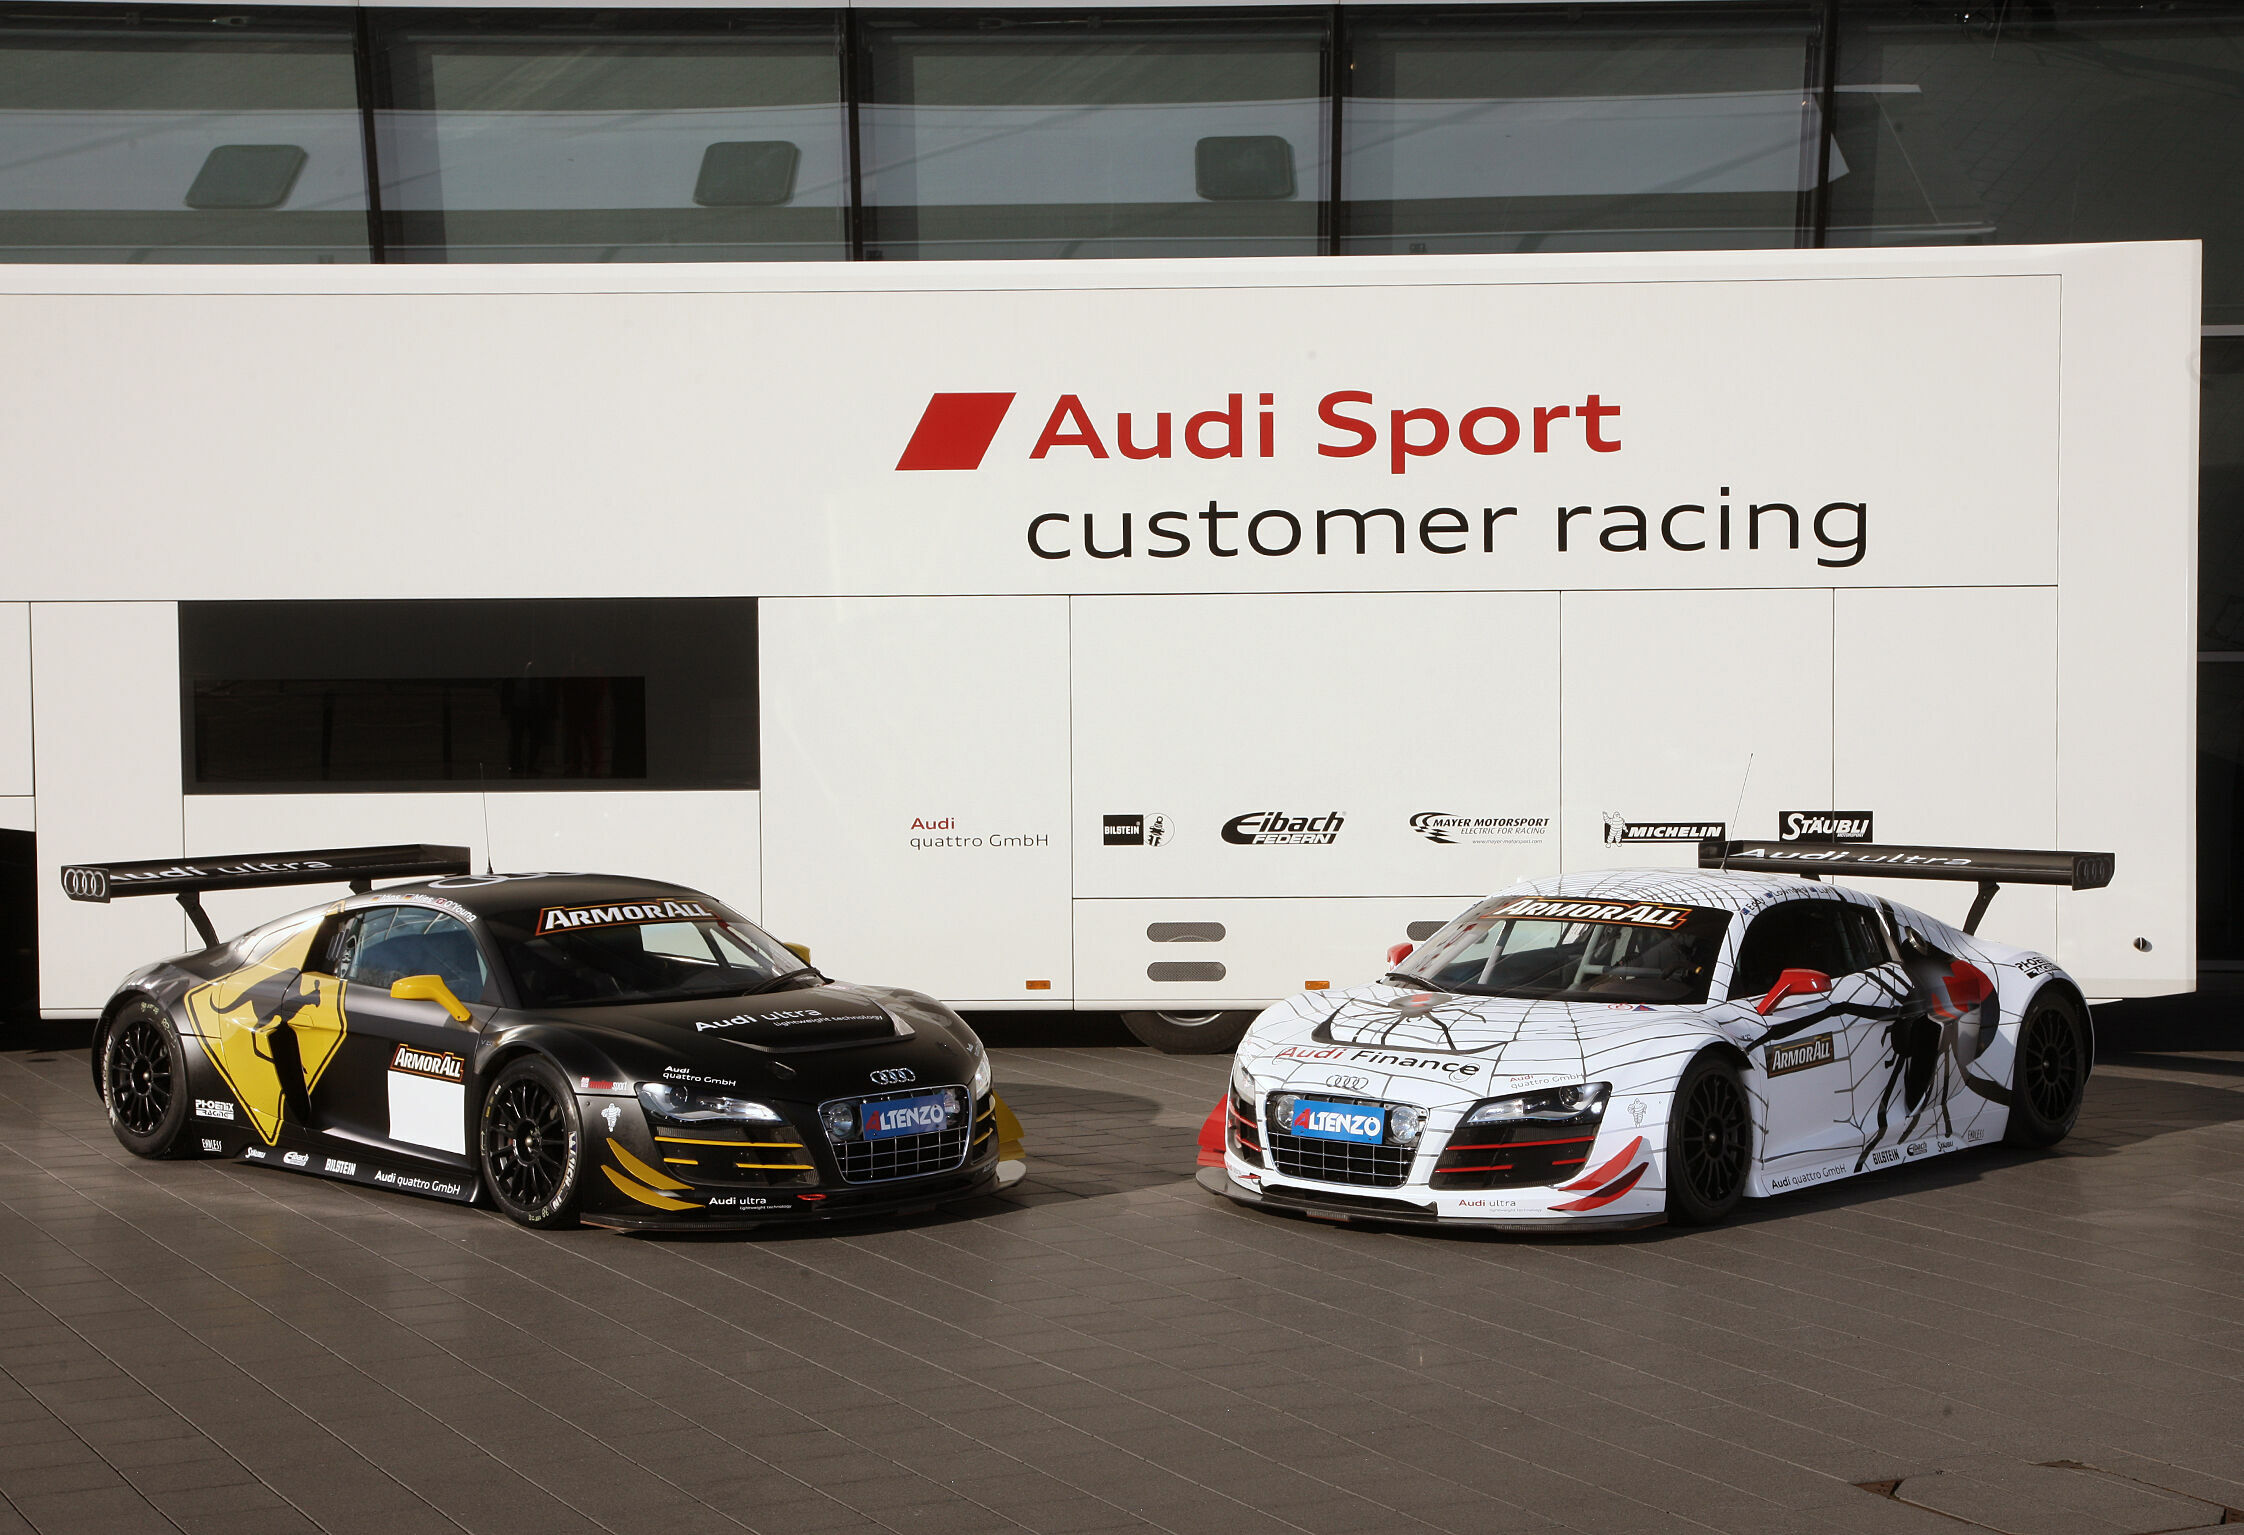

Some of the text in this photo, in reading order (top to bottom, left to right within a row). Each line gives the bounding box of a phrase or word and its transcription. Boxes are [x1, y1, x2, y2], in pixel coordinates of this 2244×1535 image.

[1030, 391, 1621, 474] Audi Sport
[1028, 487, 1866, 567] customer racing
[911, 817, 955, 830] Audi
[1104, 826, 1140, 835] BILSTEIN
[1220, 812, 1345, 843] Eibach
[1433, 818, 1549, 827] MAYER MOTORSPORT
[1460, 827, 1546, 835] ELECTRIC FOR RACING
[1782, 813, 1869, 840] STÄUBLI
[1252, 834, 1331, 845] FEDERN
[1628, 826, 1722, 837] MICHELIN
[910, 834, 1048, 850] quattro GmbH
[1730, 848, 1972, 865] Audi ultra
[218, 861, 332, 875] ultra
[445, 900, 477, 923] O'Young
[695, 1008, 822, 1032] Audi ultra
[664, 1065, 690, 1074] Audi
[1275, 1047, 1480, 1077] Audi Finance
[663, 1072, 737, 1087] quattro GmbH
[1510, 1074, 1535, 1083] Audi
[1510, 1073, 1584, 1090] quattro GmbH
[865, 1104, 944, 1132] ALTENZO
[1294, 1108, 1381, 1137] ALTENZO
[1872, 1148, 1900, 1166] BILSTEIN
[325, 1158, 357, 1176] BILSTEIN
[374, 1170, 461, 1196] Audi quattro GmbH
[1771, 1163, 1847, 1190] Audi quattro GmbH
[709, 1197, 767, 1205] Audi ultra
[1458, 1199, 1517, 1207] Audi ultra
